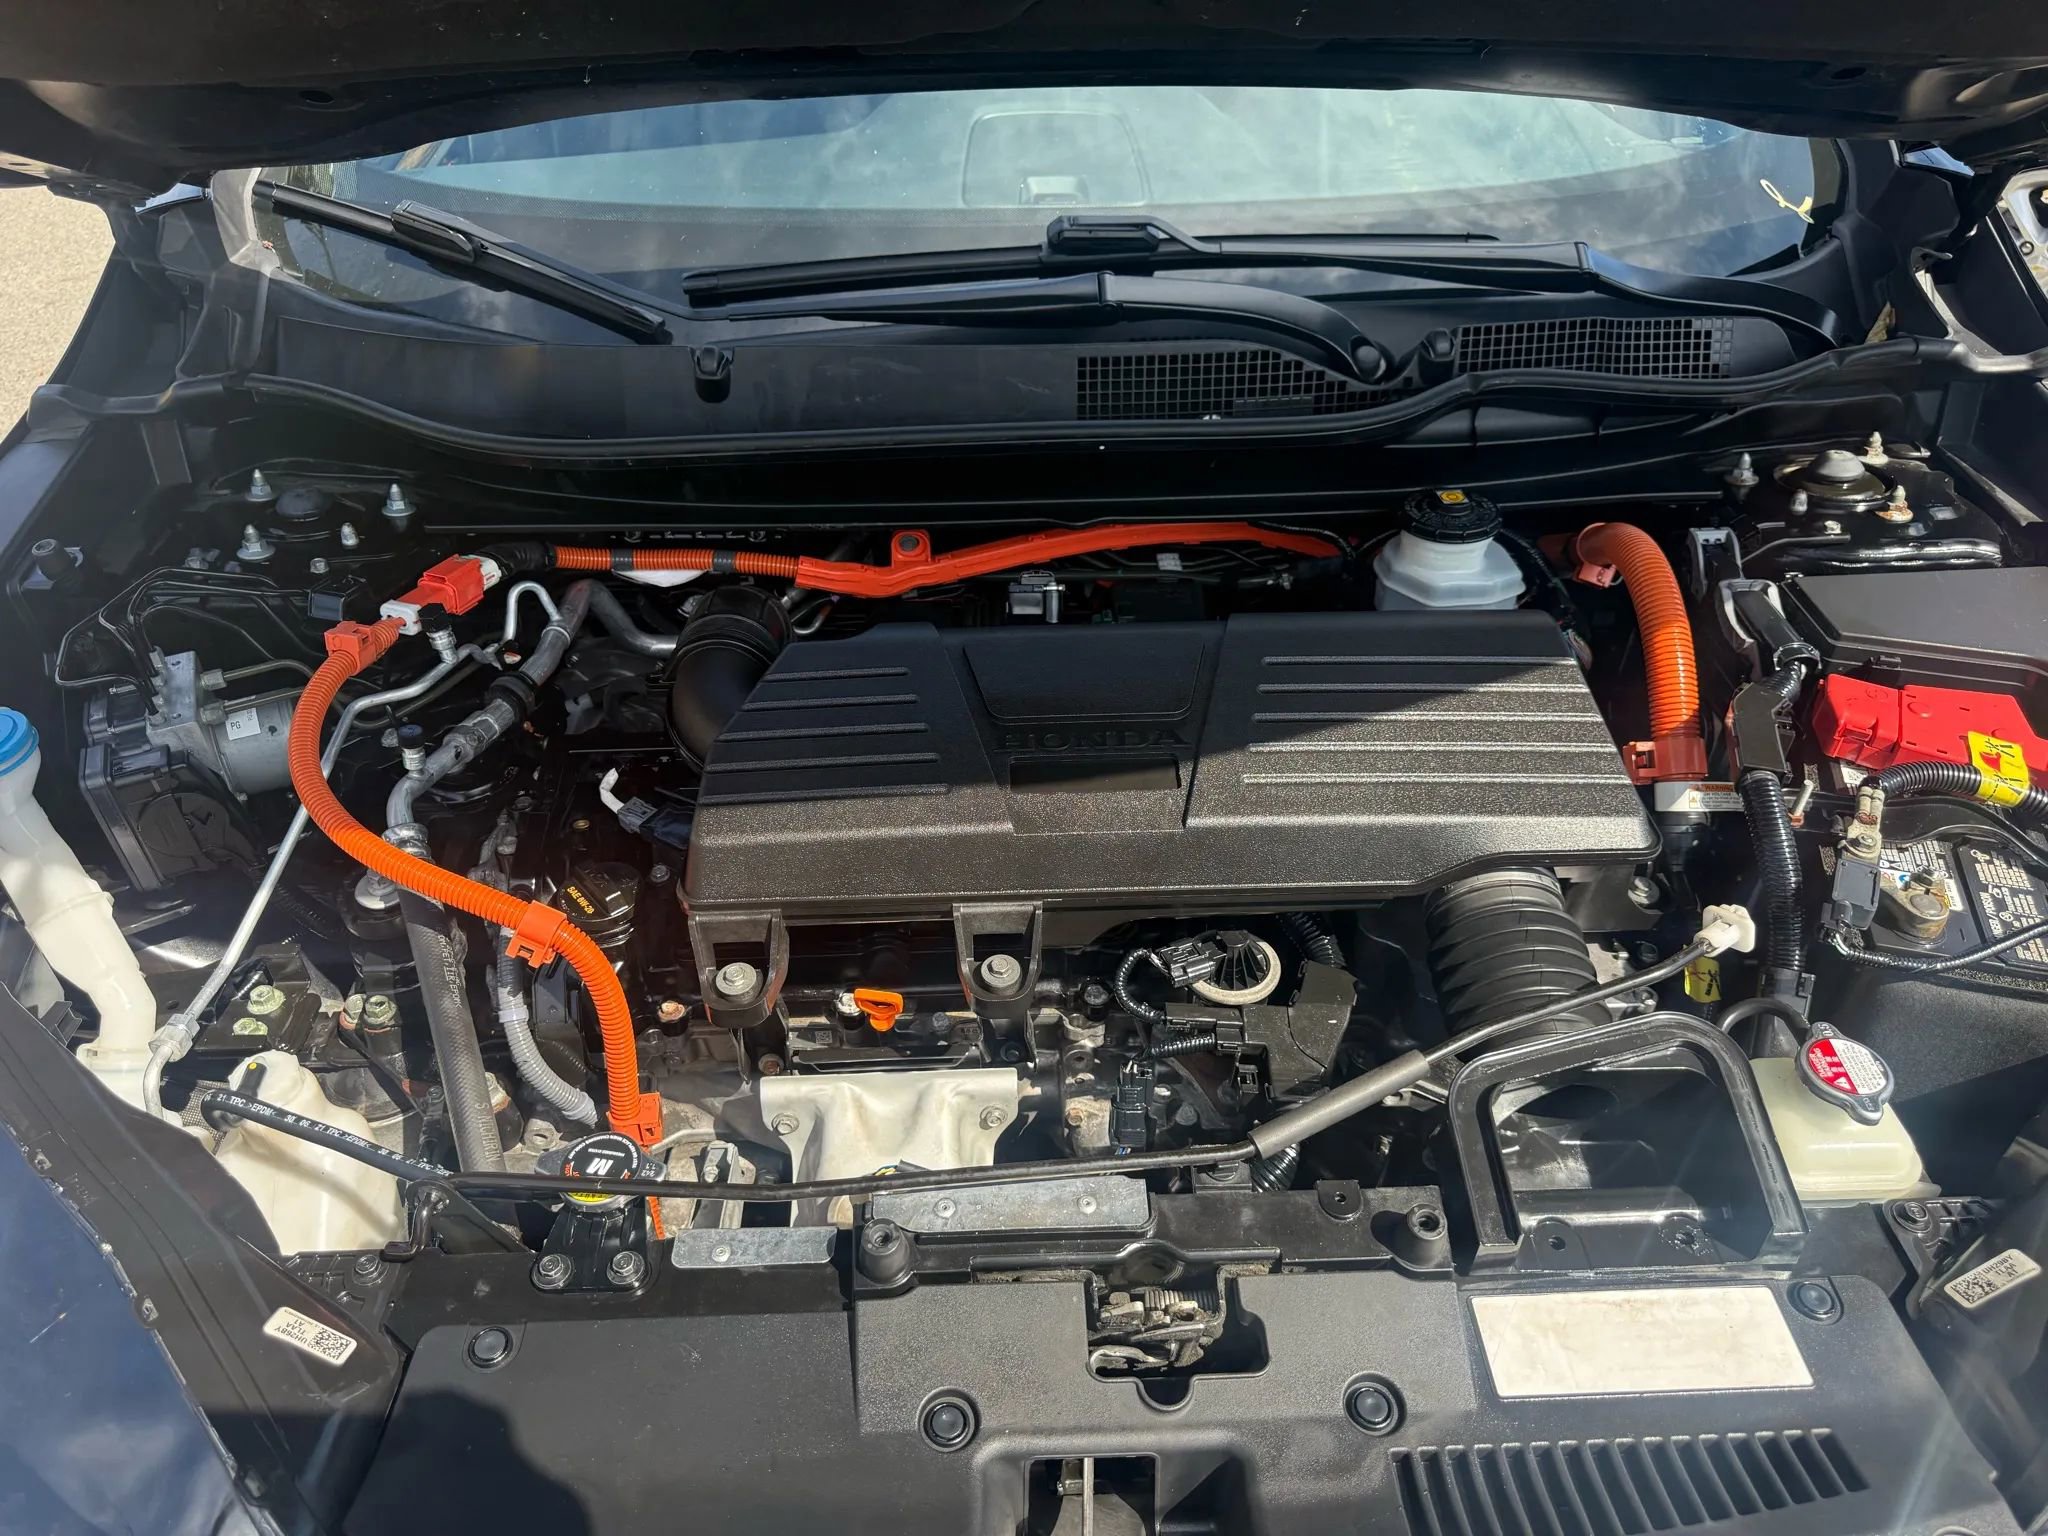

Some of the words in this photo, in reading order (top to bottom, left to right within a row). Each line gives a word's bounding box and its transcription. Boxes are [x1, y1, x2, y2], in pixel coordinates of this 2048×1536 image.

[230, 720, 241, 731] PG
[995, 727, 1193, 752] HONDA
[567, 886, 582, 900] SAE
[577, 896, 595, 915] 0W-20
[230, 1096, 246, 1107] TPC
[327, 1127, 343, 1137] TPC
[585, 1157, 614, 1176] M
[641, 1169, 656, 1177] 242
